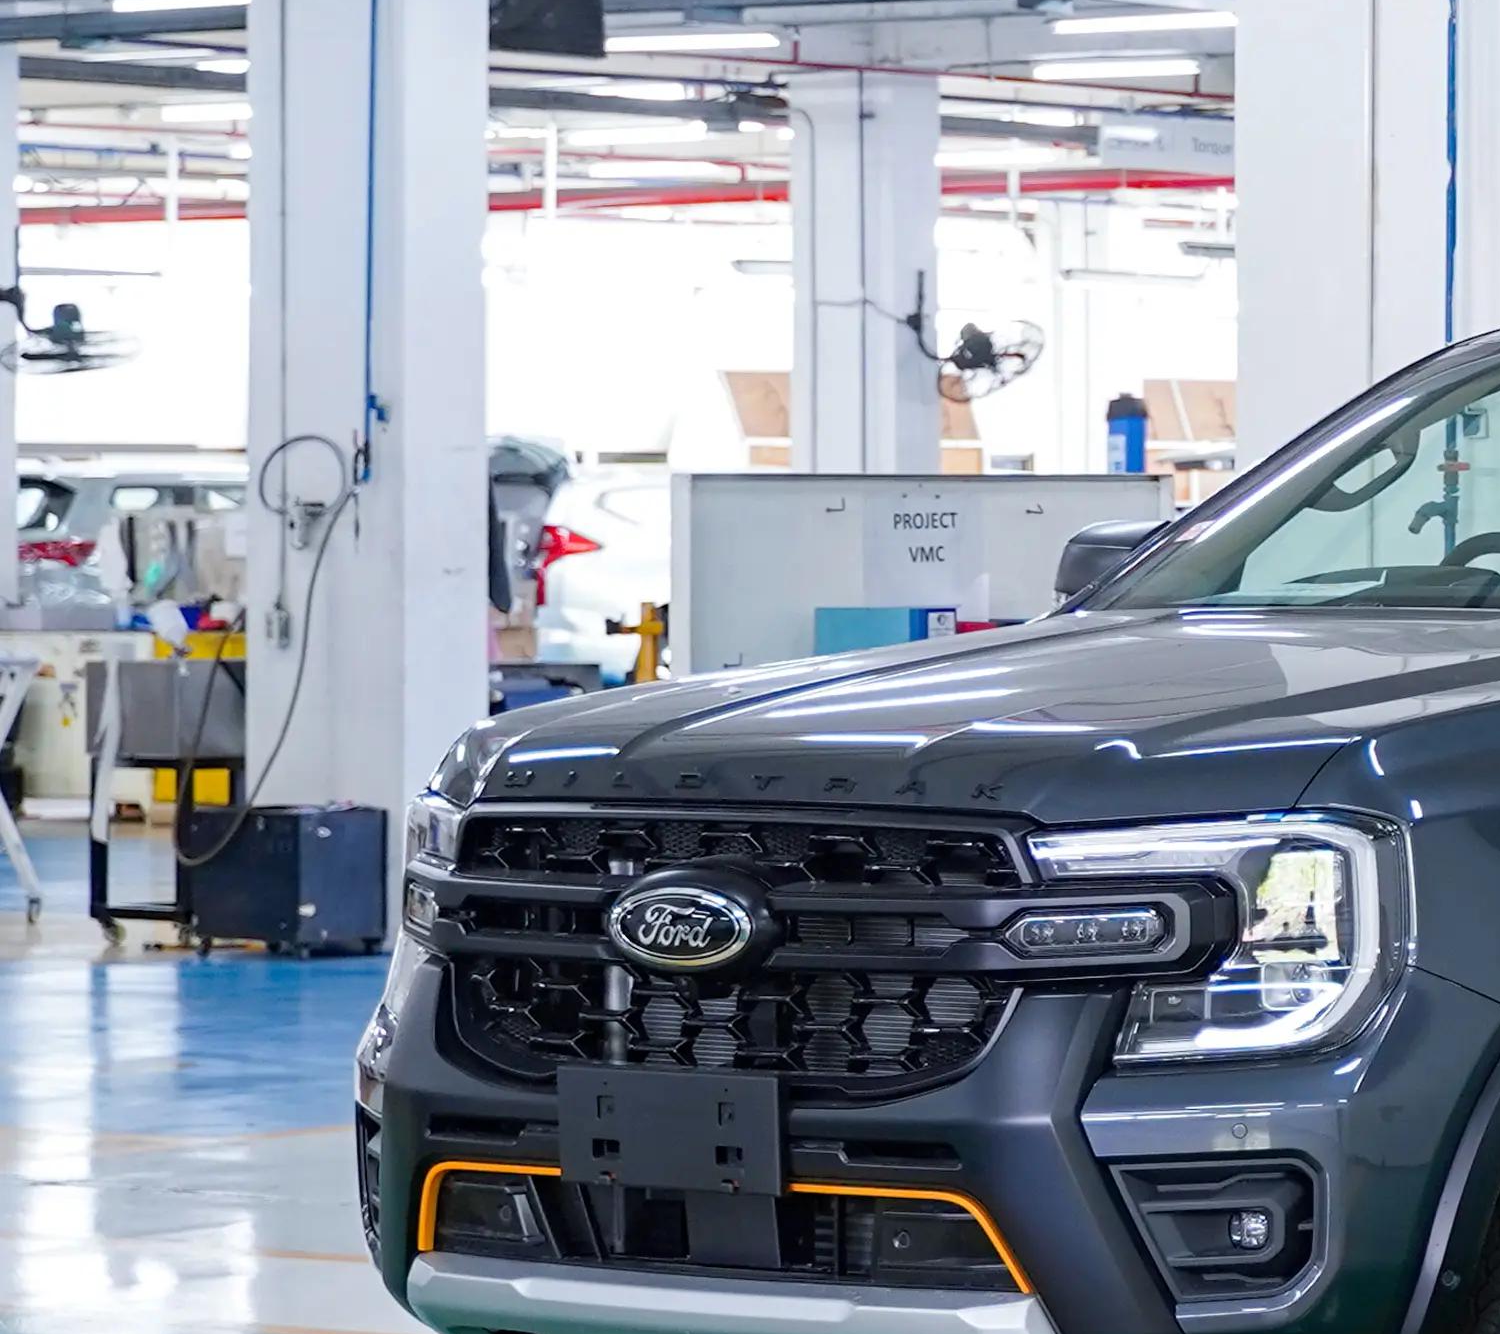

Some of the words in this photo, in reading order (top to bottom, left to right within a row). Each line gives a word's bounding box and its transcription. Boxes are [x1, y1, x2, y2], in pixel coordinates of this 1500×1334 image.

[893, 513, 958, 530] PROJECT
[909, 546, 946, 563] VMC
[504, 770, 1004, 803] WILDTRAK
[637, 902, 713, 949] Ford
